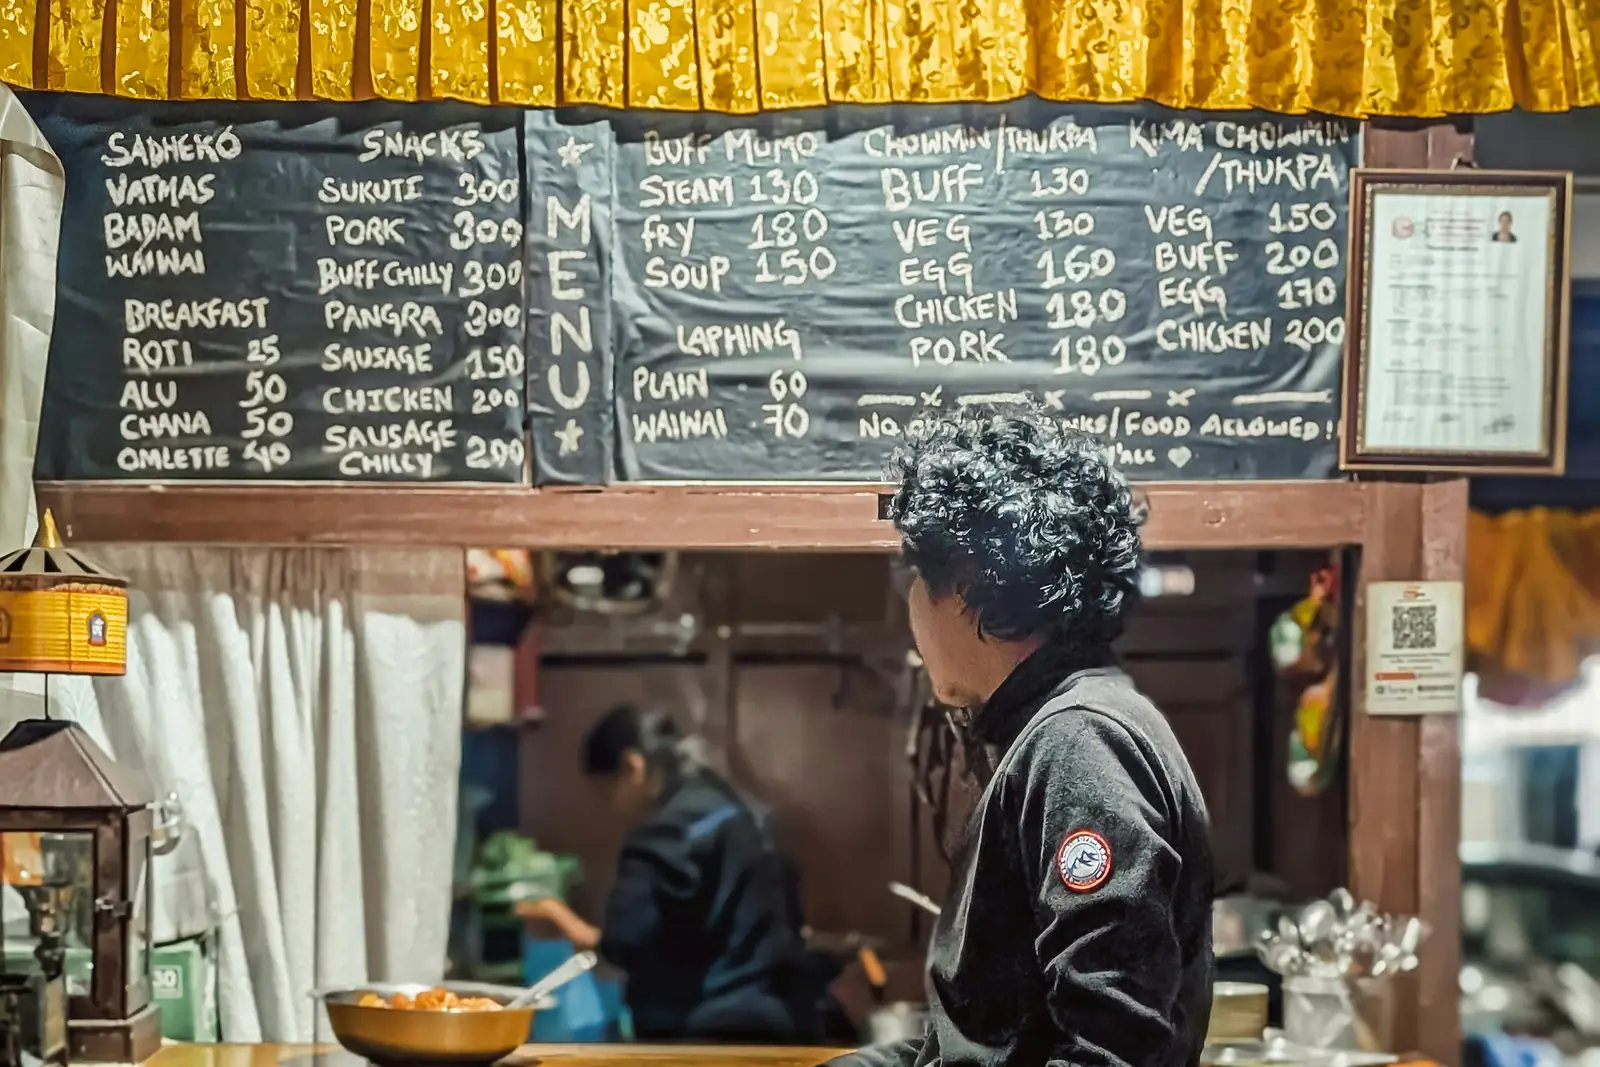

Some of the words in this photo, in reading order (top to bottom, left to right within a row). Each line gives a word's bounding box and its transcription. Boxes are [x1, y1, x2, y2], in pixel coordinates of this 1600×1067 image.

[358, 129, 485, 162] SNACKS
[645, 131, 711, 166] BUFF
[726, 130, 818, 166] MOMO
[105, 173, 215, 207] VATMAS
[318, 175, 423, 203] SUKUTI
[452, 172, 517, 206] 300
[639, 176, 733, 207] STEAM
[749, 170, 818, 205] 130
[881, 164, 983, 212] BUFF
[1030, 168, 1089, 198] 130
[103, 213, 201, 249] BADAM
[326, 217, 404, 247] PORK
[449, 215, 522, 250] 300
[748, 209, 828, 249] 180
[893, 214, 972, 254] VEG
[1033, 212, 1094, 240] 130
[1144, 205, 1211, 239] VEG
[1268, 202, 1336, 234] 150
[644, 257, 730, 292] SOUP
[755, 247, 836, 284] 150
[899, 252, 973, 295] EGG
[1036, 248, 1115, 288] 160
[1155, 240, 1238, 274] BUFF
[1265, 239, 1339, 275] 200
[317, 258, 380, 295] BUFF
[458, 261, 522, 298] 300
[125, 298, 269, 334] BREAKFAST
[546, 194, 591, 409] MENU
[895, 288, 1017, 329] CHICKEN
[1045, 289, 1127, 329] 180
[1158, 277, 1228, 320] EGG
[1278, 277, 1336, 309] 170
[324, 302, 443, 337] PANGRA
[464, 301, 519, 336] 300
[1156, 318, 1271, 354] CHICKEN
[1284, 317, 1345, 350] 200
[123, 338, 192, 375] ROTI
[247, 335, 281, 365] 25
[677, 319, 800, 360] LAPHING
[911, 331, 1011, 368] PORK
[1050, 335, 1126, 376] 180
[321, 344, 433, 375] SAUSAGE
[464, 344, 524, 381] 150
[120, 381, 177, 410] ALU
[238, 371, 287, 409] 50
[322, 386, 452, 414] CHICKEN
[472, 389, 519, 415] 200
[633, 368, 708, 403] PLAIN
[768, 370, 807, 401] 60
[120, 412, 211, 439] CHANA
[241, 411, 294, 439] 50
[324, 420, 456, 451] SAUSAGE
[633, 409, 728, 442] WAIWAI
[762, 403, 809, 438] 70
[117, 447, 230, 471] OMLETTE
[242, 442, 291, 472] 40
[339, 451, 433, 476] CHILLY
[464, 435, 524, 471] 200
